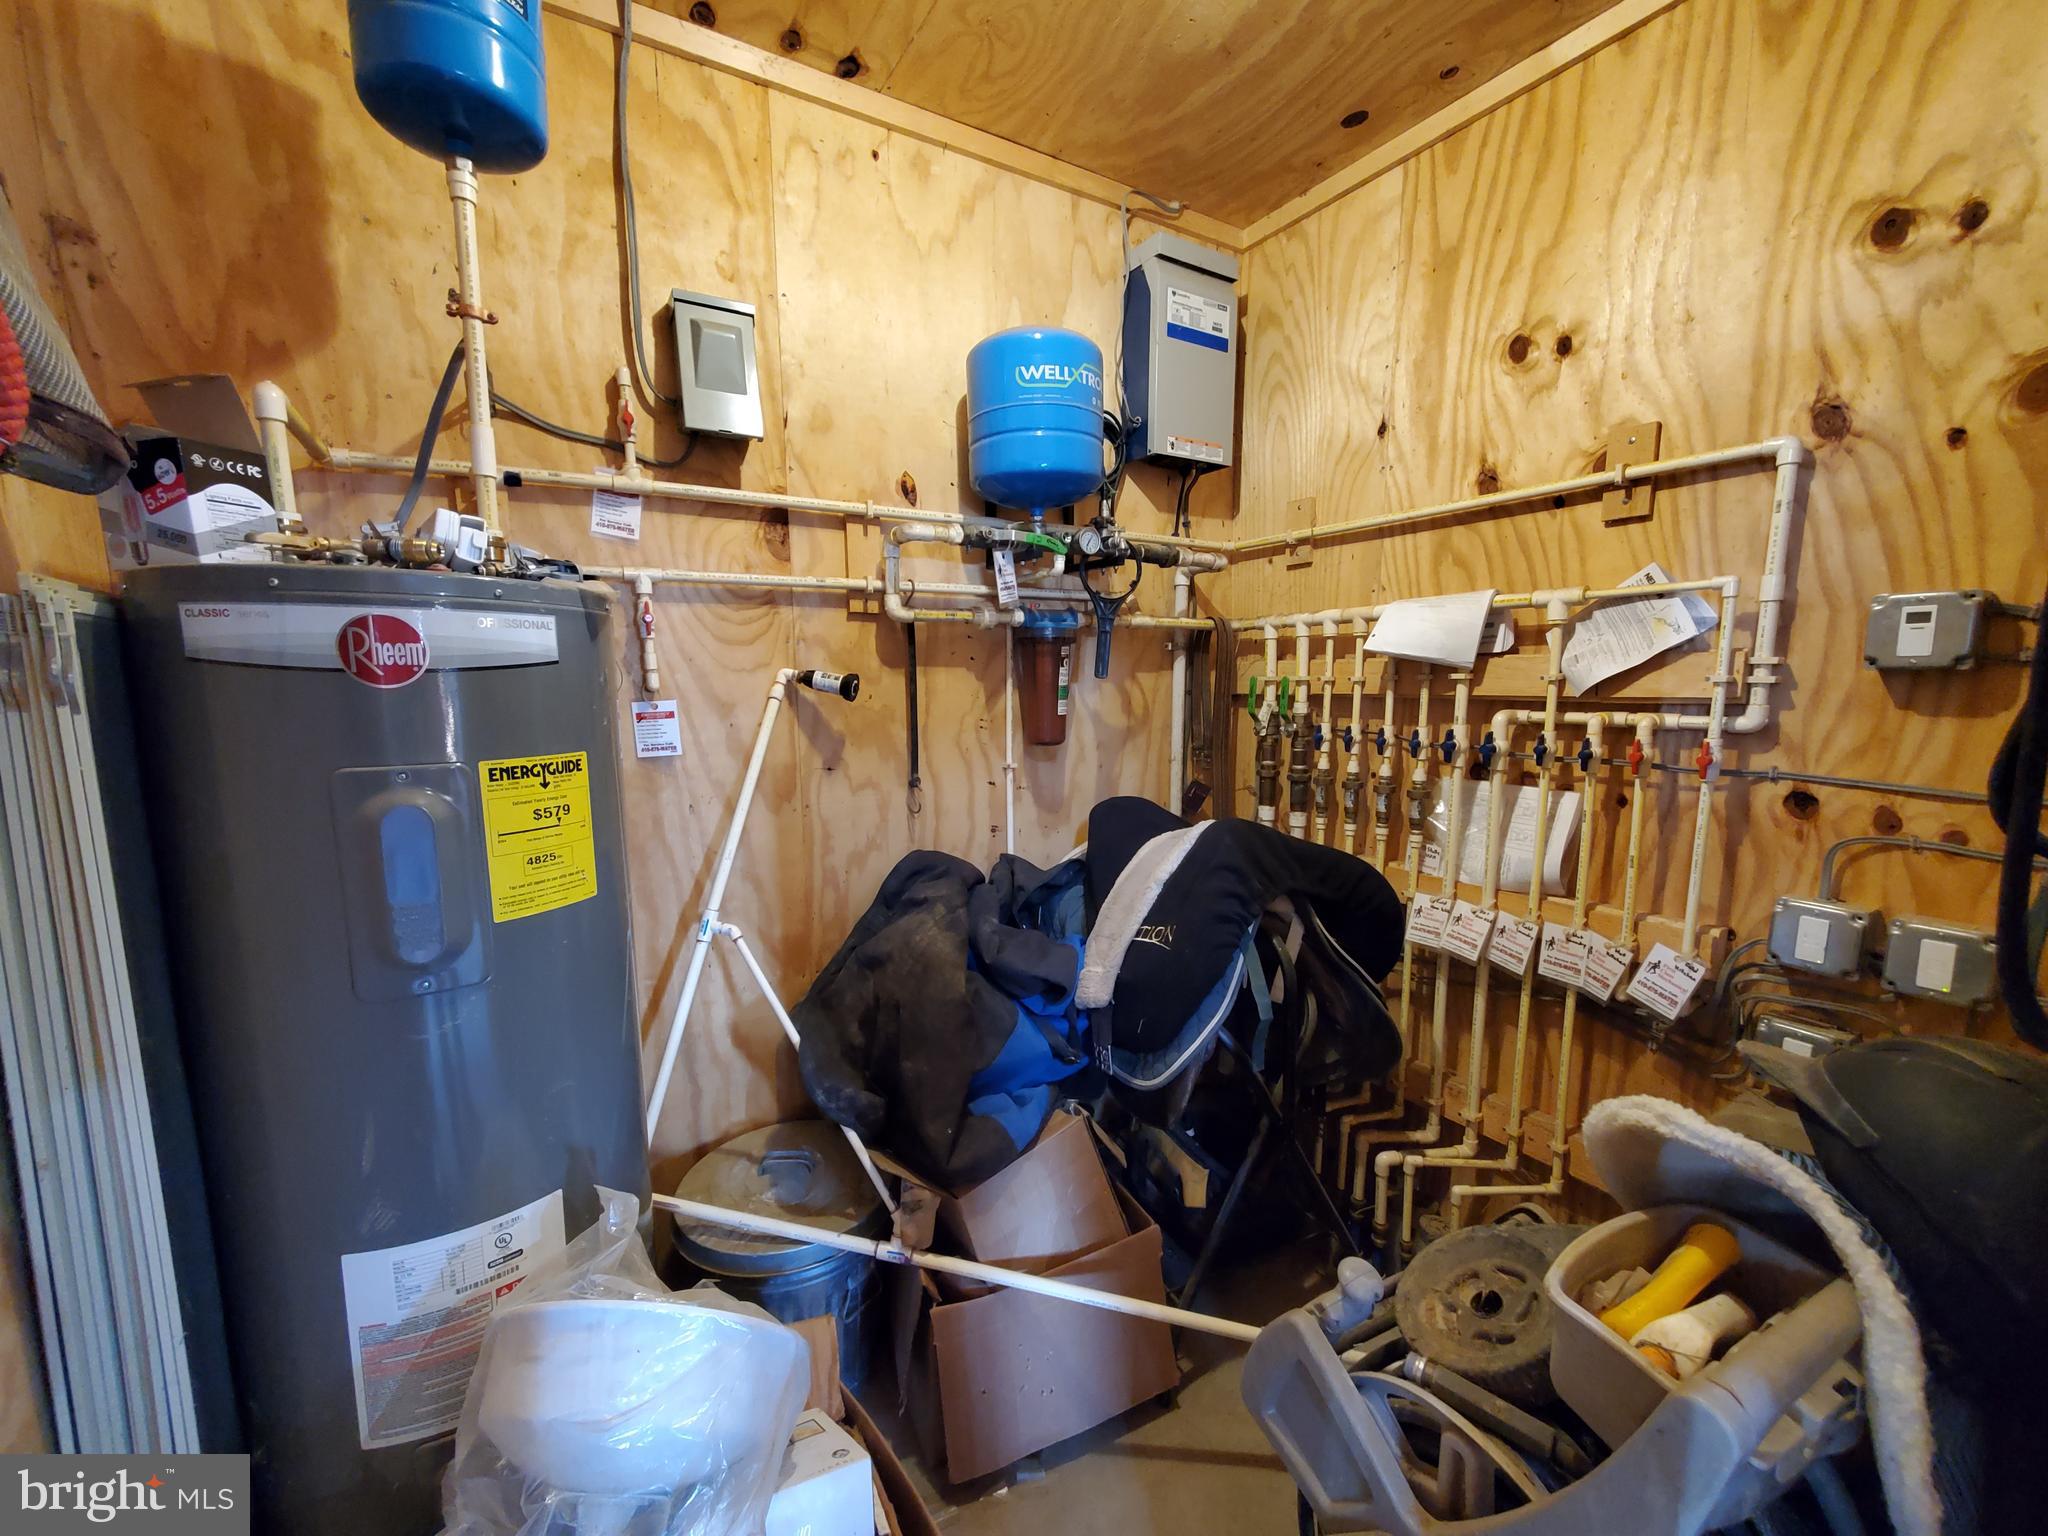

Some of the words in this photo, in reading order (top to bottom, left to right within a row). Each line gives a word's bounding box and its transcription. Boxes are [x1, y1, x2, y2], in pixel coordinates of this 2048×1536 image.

[184, 608, 230, 618] CLASSIC
[347, 614, 424, 676] Rheem
[487, 758, 583, 783] ENERGYGUIDE
[533, 803, 571, 821] $579
[526, 851, 557, 866] 4825
